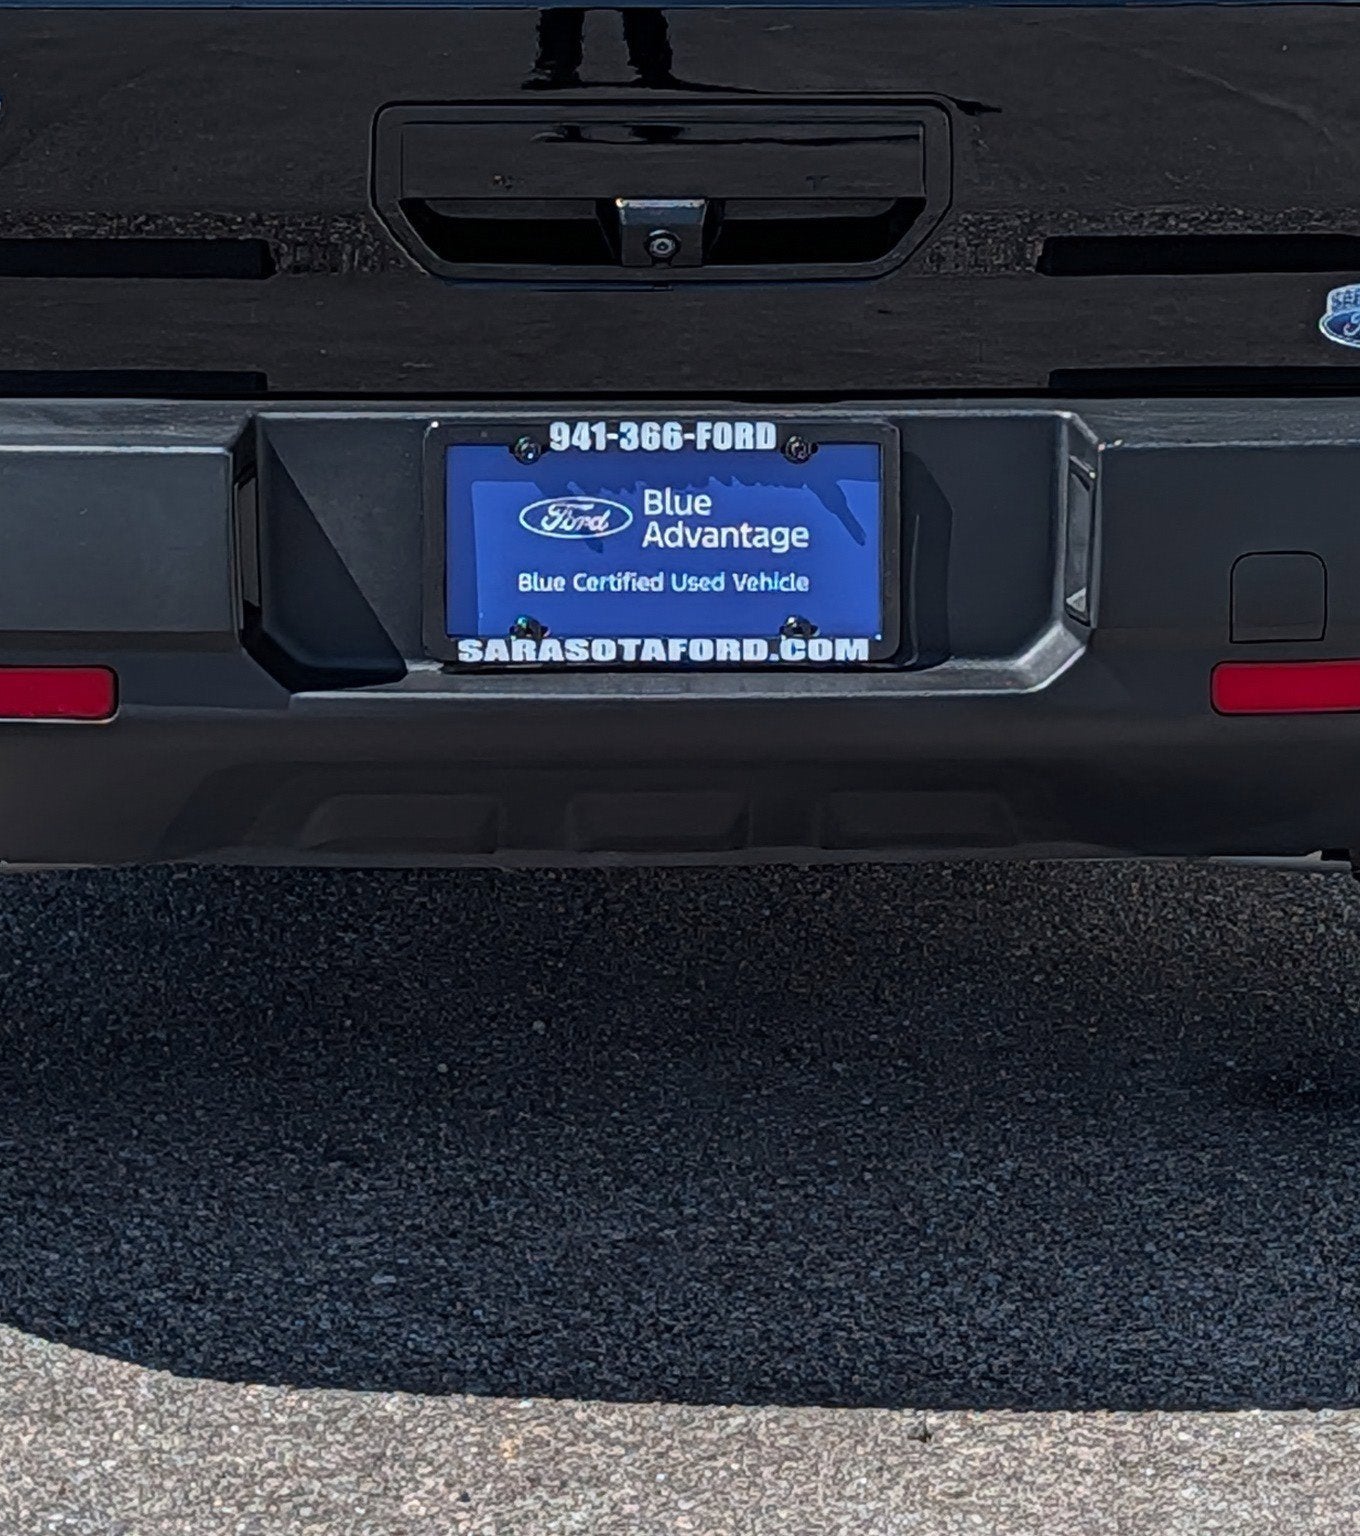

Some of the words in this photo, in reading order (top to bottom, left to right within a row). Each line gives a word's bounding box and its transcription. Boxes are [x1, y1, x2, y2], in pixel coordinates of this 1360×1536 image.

[548, 420, 778, 452] 941-366-FORD
[643, 489, 712, 516] Blue
[540, 502, 611, 532] Ford
[642, 520, 810, 553] Advantage
[518, 572, 566, 592] Blue
[572, 572, 664, 592] Certified
[671, 572, 725, 592] Used
[732, 572, 810, 592] Vehicle
[457, 637, 870, 663] SARASOTAFORD.COM
